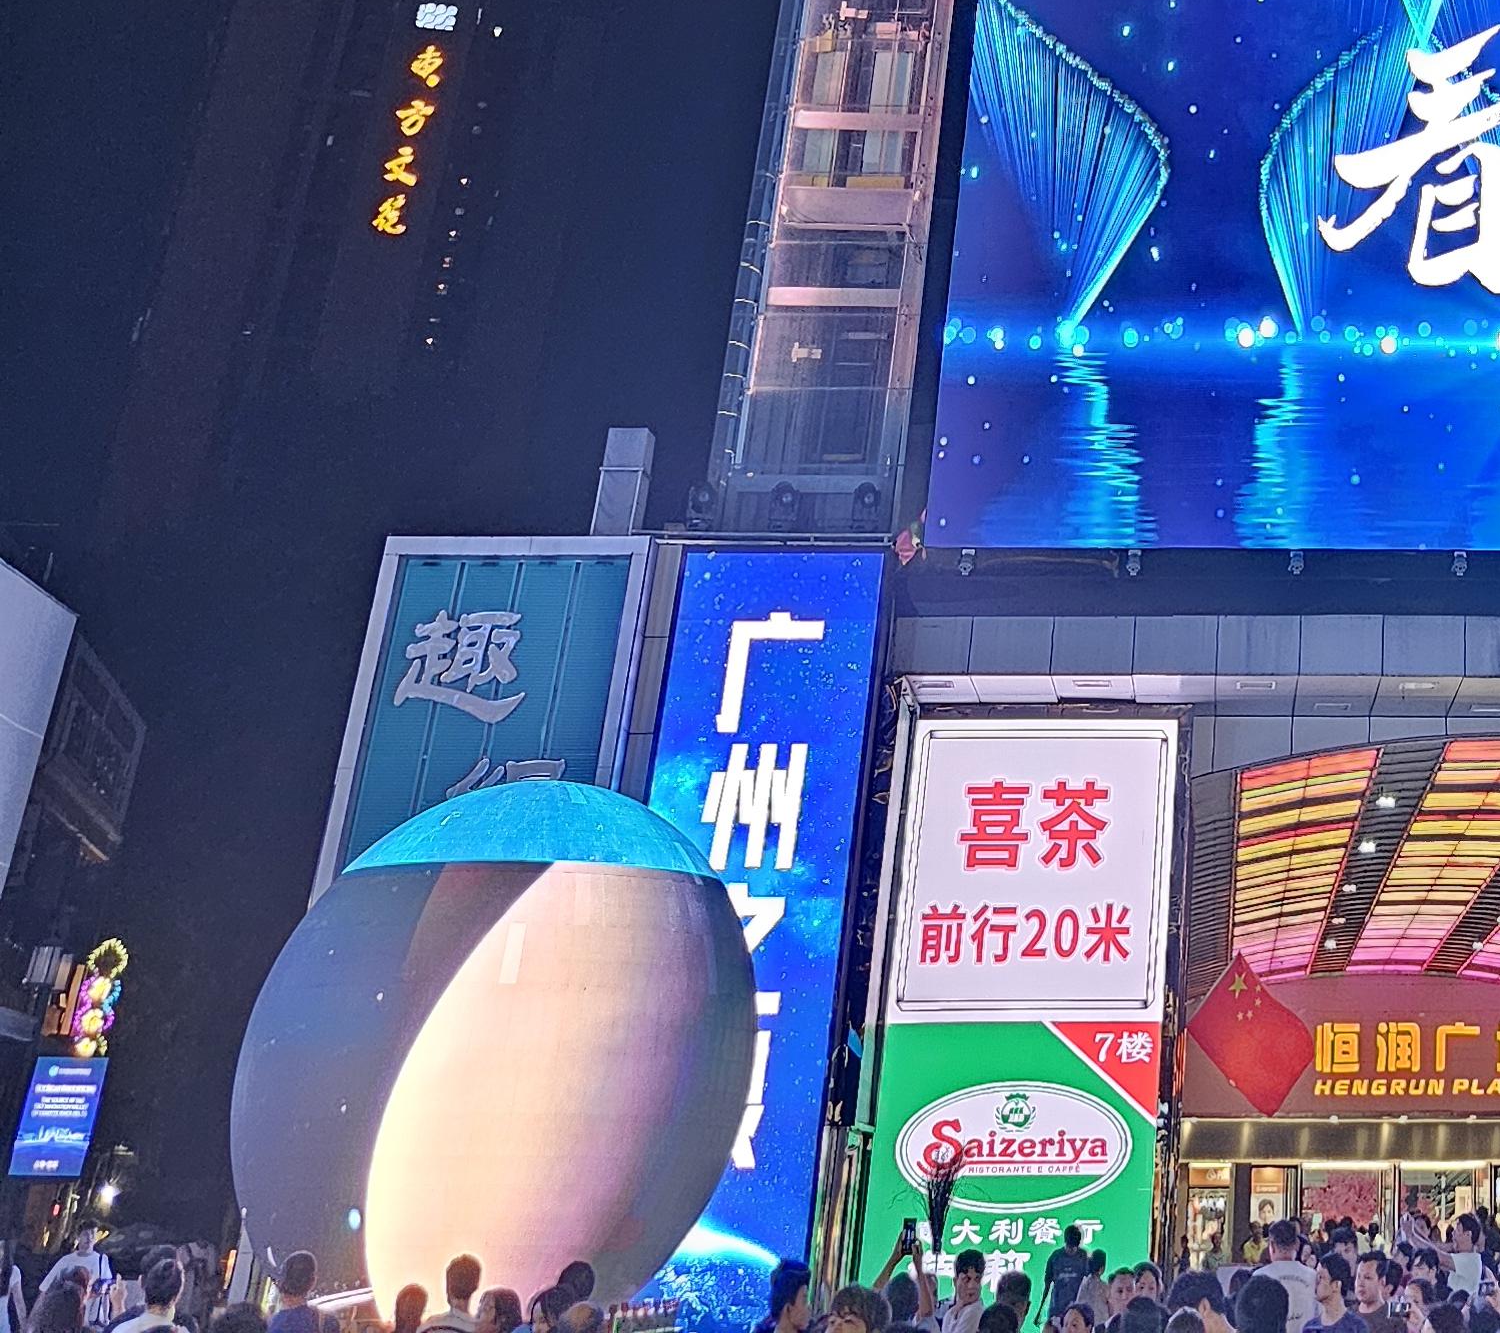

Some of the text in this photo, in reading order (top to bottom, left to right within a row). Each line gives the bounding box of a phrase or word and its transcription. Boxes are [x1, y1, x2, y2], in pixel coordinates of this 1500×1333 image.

[956, 779, 1111, 872] 喜茶
[701, 611, 825, 1171] 广州
[918, 903, 1132, 966] 前行20米
[1093, 1030, 1154, 1067] 7楼
[1314, 1079, 1445, 1095] HENGRUN
[917, 1118, 1108, 1177] Saizeriya
